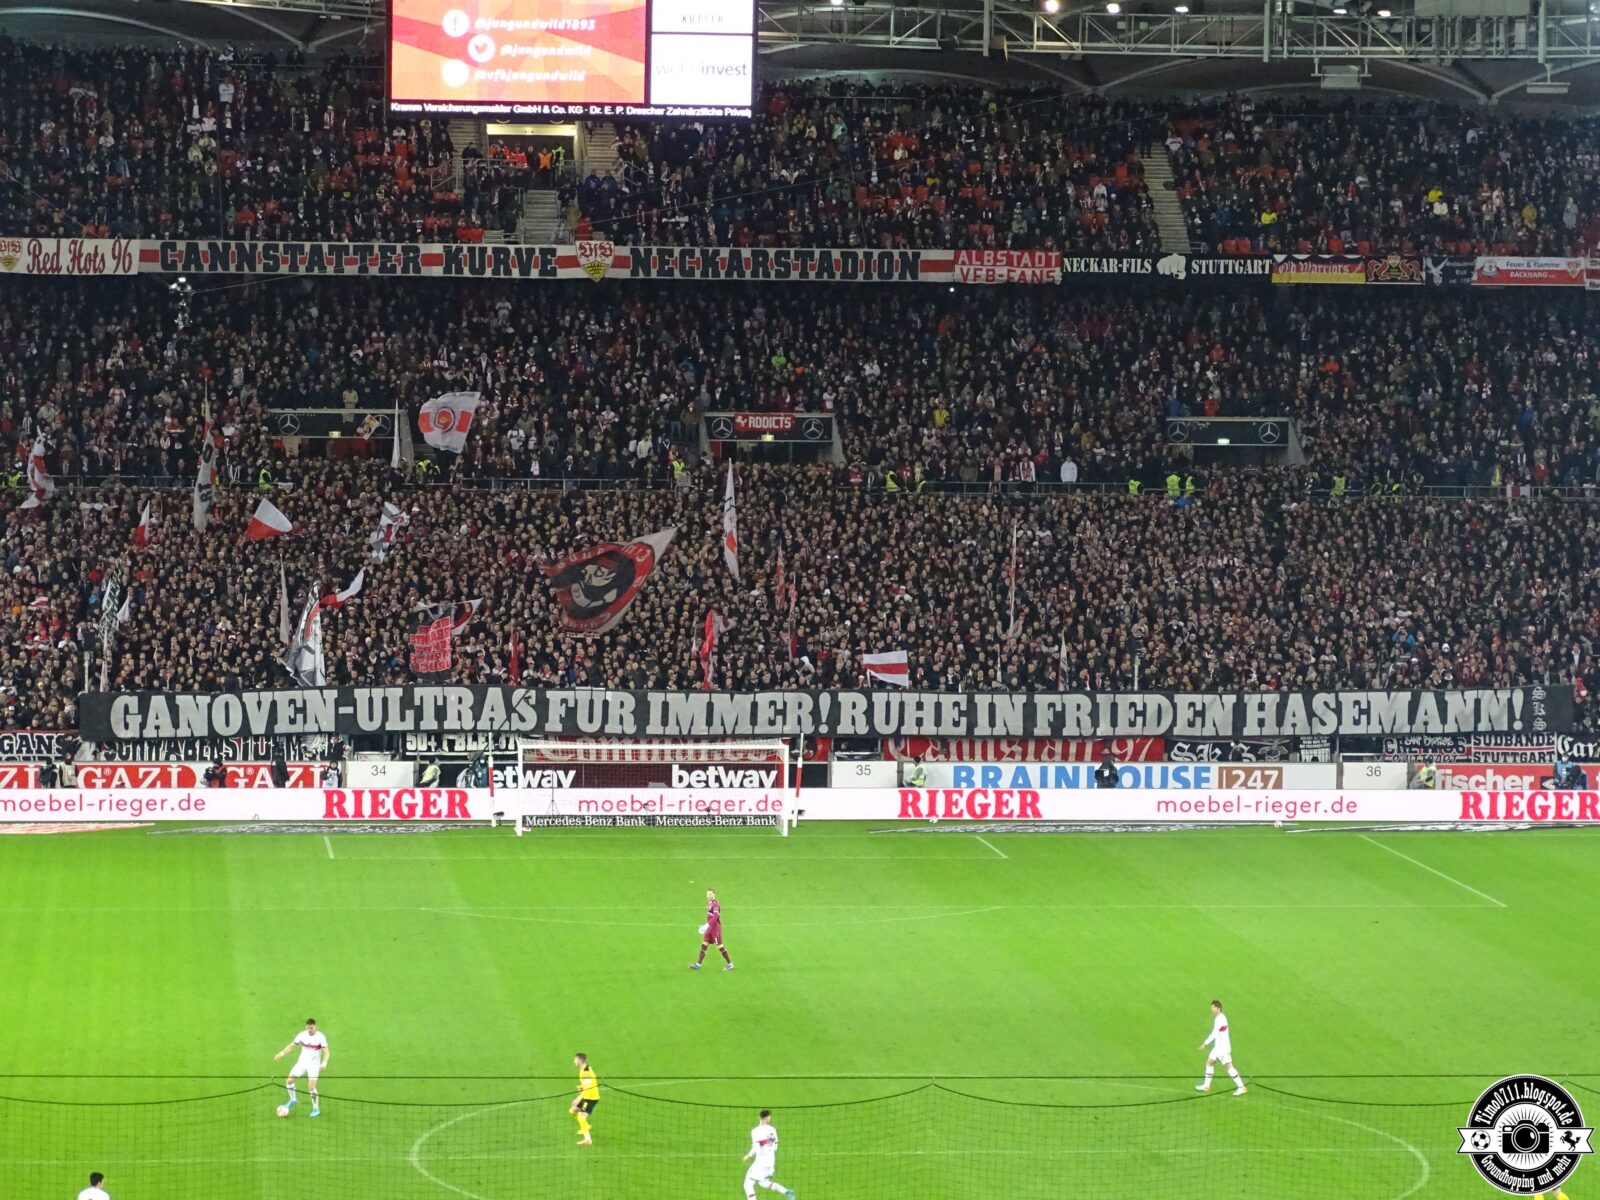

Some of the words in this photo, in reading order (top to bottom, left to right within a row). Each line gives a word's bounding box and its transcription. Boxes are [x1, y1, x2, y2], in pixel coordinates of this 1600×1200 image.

[513, 104, 541, 114] GmbH
[543, 105, 550, 113] &
[551, 105, 566, 114] Co.
[568, 105, 583, 114] KG
[590, 106, 602, 115] Dr.
[604, 106, 614, 115] E.
[26, 239, 62, 275] Red
[111, 239, 133, 275] 96
[160, 241, 421, 276] CANNSTATTER
[442, 245, 557, 278] KURVE
[630, 247, 921, 281] NECKARSTADION
[957, 250, 1060, 268] ALBSTADT
[1063, 256, 1152, 274] NECKAR-FILS
[1191, 257, 1272, 275] STUTTGART
[110, 687, 538, 740] GANOVEN-ULTRAS
[646, 691, 831, 735] IMMER!
[836, 692, 968, 736] RUHE
[973, 693, 1028, 736] IN
[1033, 692, 1237, 737] FRIEDEN
[1242, 688, 1524, 736] HASEMANN!
[1473, 751, 1556, 763] STUTTGART
[371, 764, 387, 776] 34
[493, 765, 577, 788] etway
[671, 764, 778, 788] betway
[855, 764, 872, 776] 35
[1231, 769, 1279, 789] 247
[1366, 765, 1382, 777] 36
[1436, 768, 1535, 789] fischer
[322, 789, 472, 819] RIEGER
[578, 794, 783, 816] moebel-rieger.de
[897, 789, 1043, 819] RIEGER
[1157, 794, 1358, 819] moebel-rieger.de
[1459, 790, 1600, 821] RIEGER
[525, 815, 613, 827] Mercedes-Benz
[616, 815, 647, 827] Bank
[656, 815, 744, 827] Mercedes-Benz
[747, 815, 777, 827] Bank
